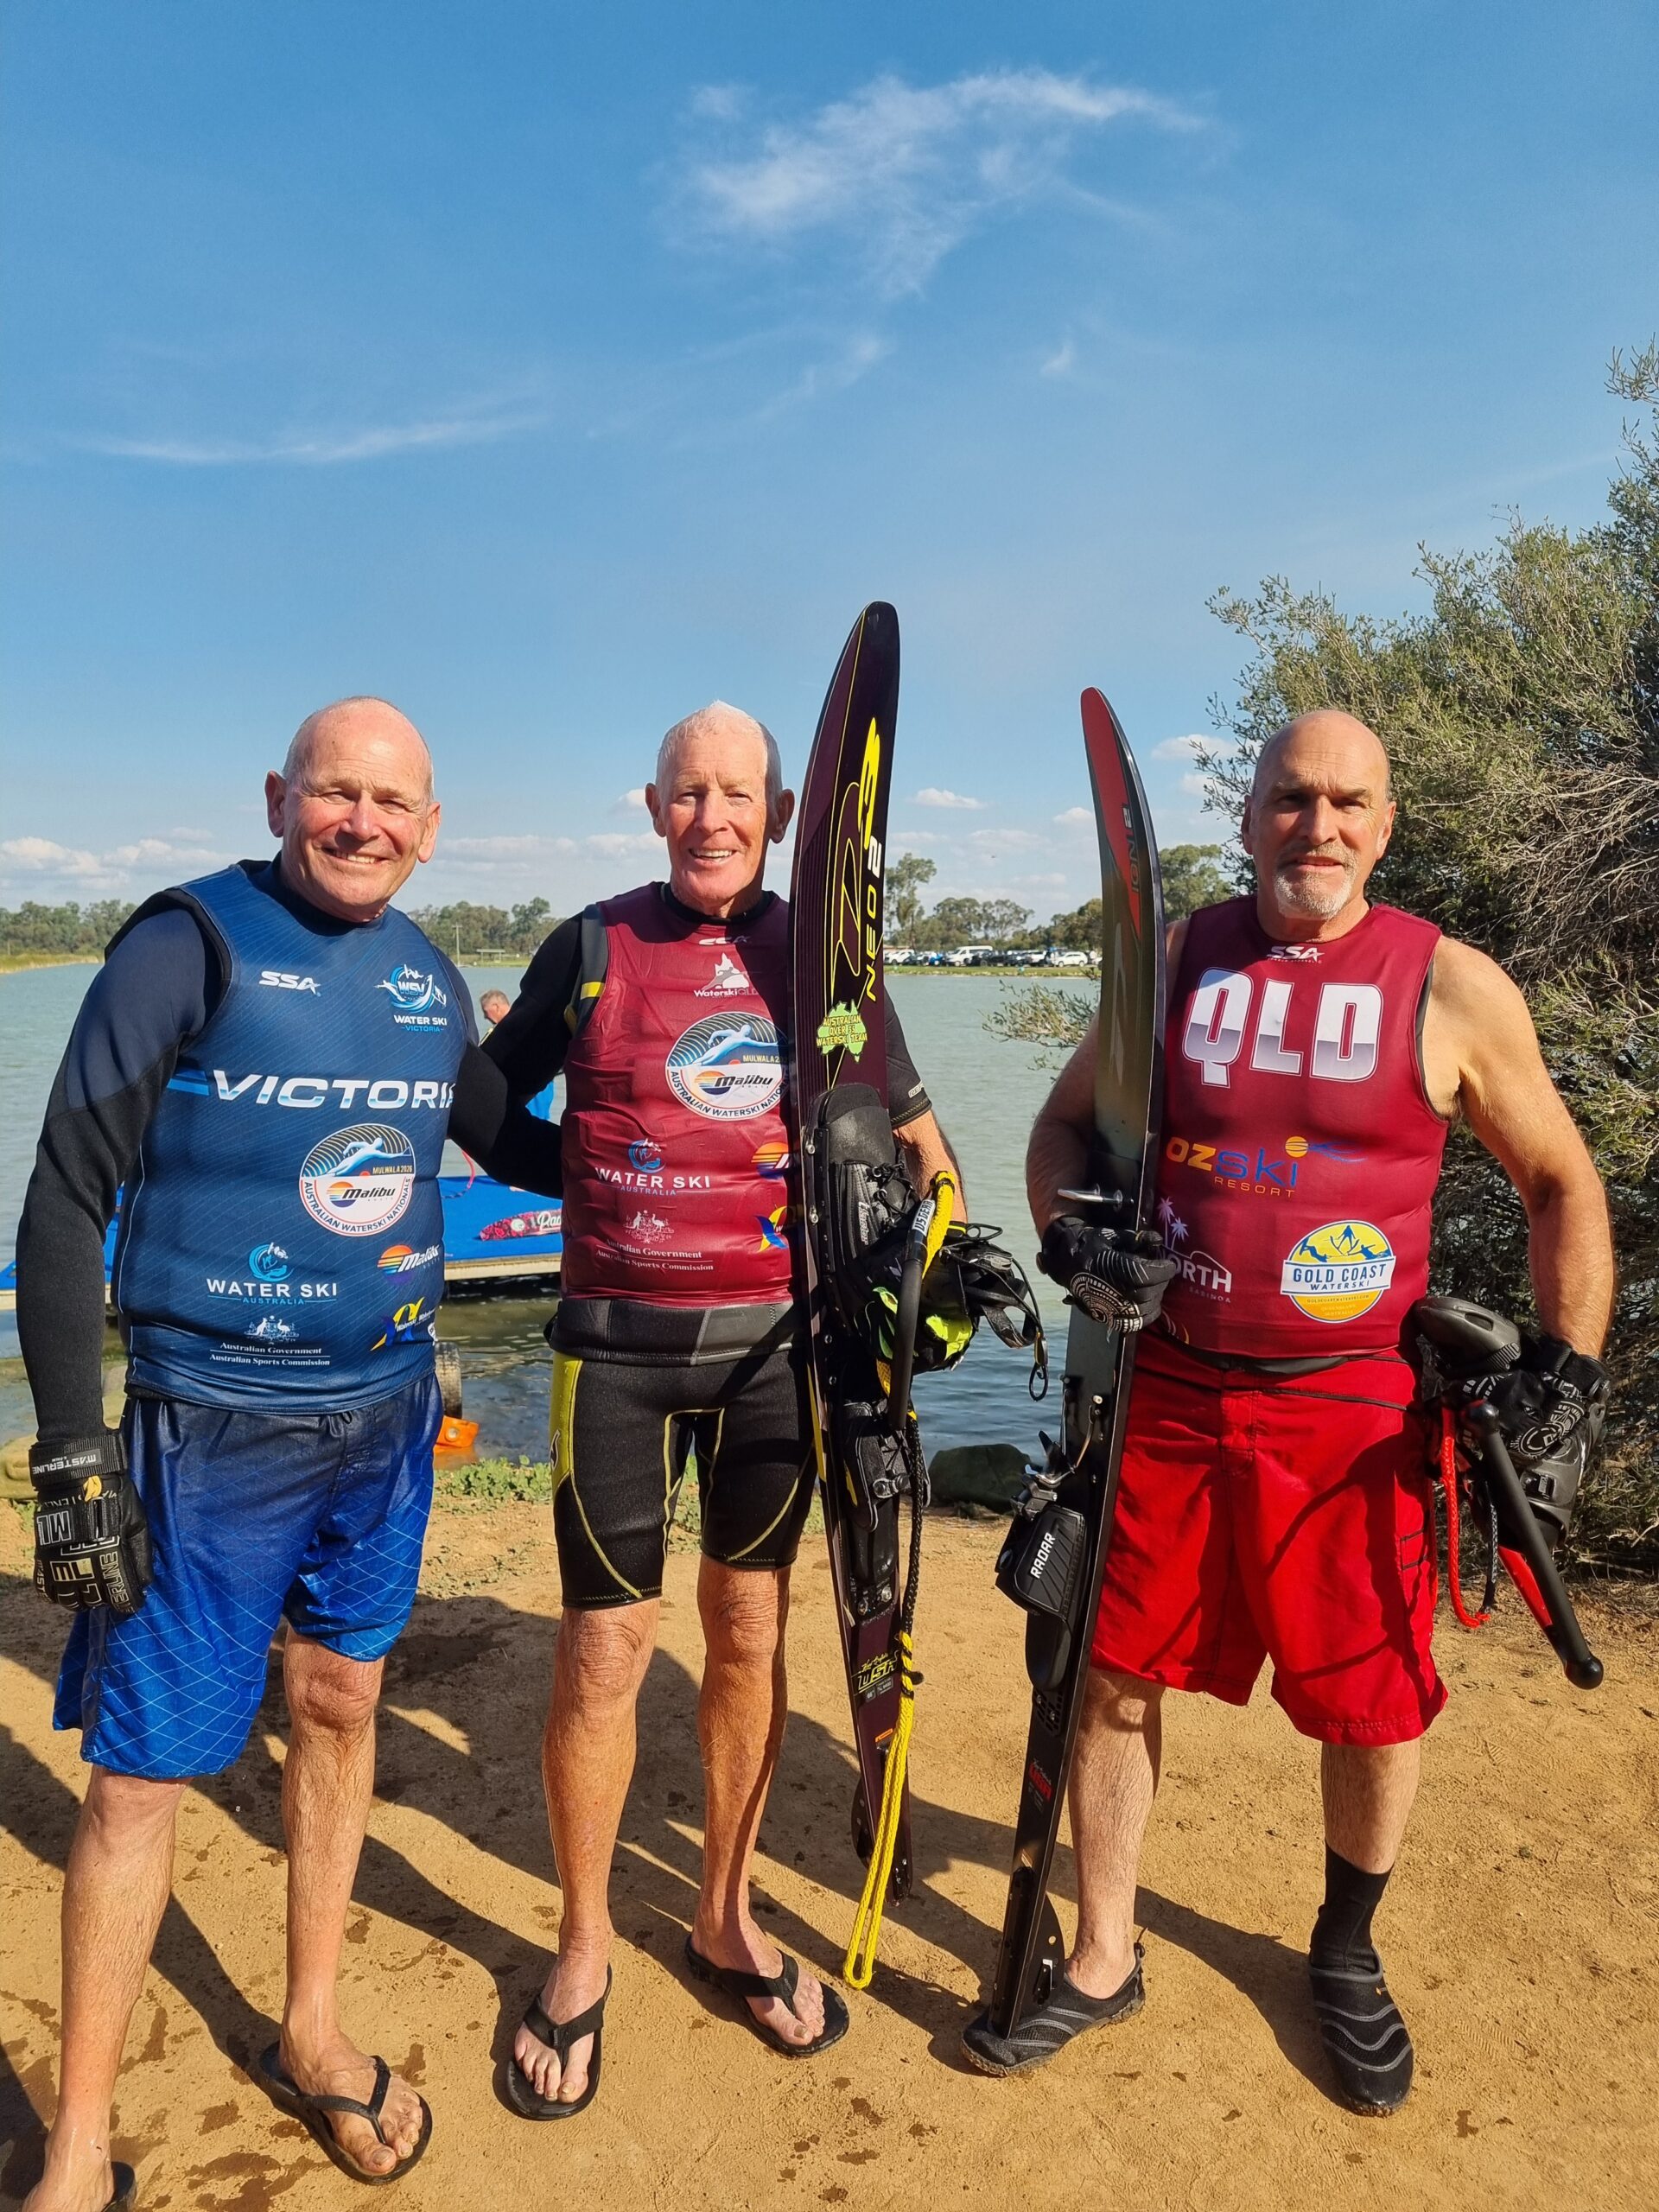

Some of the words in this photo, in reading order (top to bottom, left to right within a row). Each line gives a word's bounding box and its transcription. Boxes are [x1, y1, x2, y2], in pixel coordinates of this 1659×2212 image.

[1266, 945, 1325, 963] SSA
[259, 970, 321, 995] SSA
[393, 1014, 429, 1026] WATER
[432, 1015, 448, 1027] SKI
[823, 1014, 861, 1027] AUSTRALIAN
[404, 1025, 441, 1033] VICTORIA
[830, 1026, 846, 1036] OVER
[1181, 967, 1384, 1089] QLD
[816, 1035, 849, 1046] WATERSKI
[850, 1033, 868, 1043] TEAM
[715, 1074, 774, 1087] Malibu
[671, 1071, 711, 1113] AUSTRALIAN
[712, 1106, 760, 1117] WATERSKI
[594, 1167, 664, 1189] WATER
[673, 1175, 711, 1189] SKI
[342, 1186, 396, 1199] Malibu
[620, 1185, 677, 1196] AUSTRALIA
[1214, 1176, 1295, 1198] RESORT
[304, 1181, 341, 1229] AUSTRALIAN
[341, 1219, 386, 1232] WATERSKI
[387, 1178, 411, 1221] NATIONALS
[643, 1247, 702, 1259] Government
[631, 1259, 660, 1268] Sports
[662, 1262, 714, 1271] Commission
[1160, 1251, 1232, 1294] ORTH
[1293, 1268, 1334, 1283] GOLD
[1342, 1263, 1387, 1282] COAST
[206, 1278, 291, 1298] WATER
[300, 1282, 337, 1298] SKI
[1310, 1280, 1370, 1291] WATERSKI
[242, 1297, 305, 1306] AUSTRALIA
[219, 1342, 266, 1354] Australian
[209, 1354, 251, 1364] Australian
[252, 1357, 280, 1366] Sports
[33, 1453, 97, 1475] MASTERLINE
[1030, 1532, 1056, 1580] RADAR
